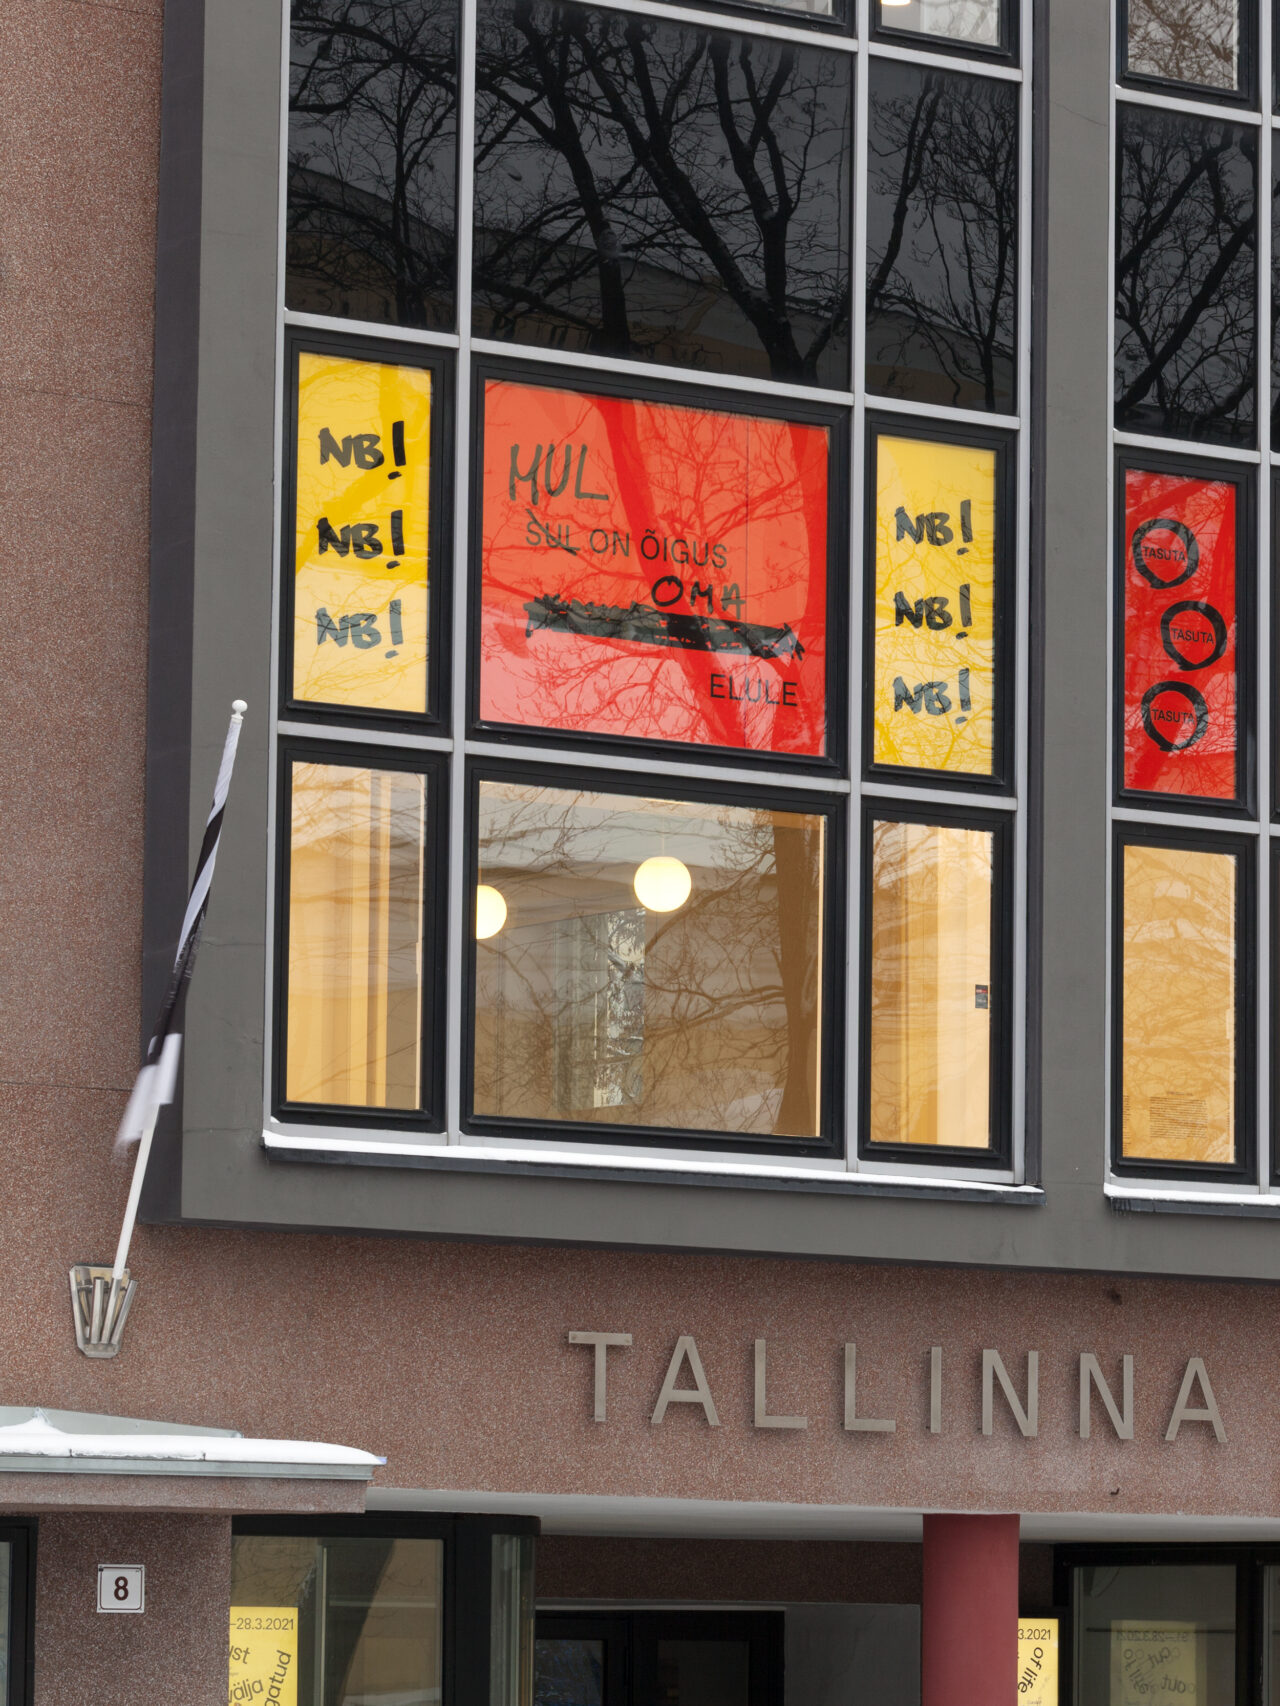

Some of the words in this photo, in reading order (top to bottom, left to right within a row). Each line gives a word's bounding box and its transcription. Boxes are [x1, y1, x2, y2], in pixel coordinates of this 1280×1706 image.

[318, 420, 407, 480] NB!
[508, 442, 609, 505] MUL
[317, 509, 405, 569] NB!
[589, 530, 630, 557] ON
[641, 527, 728, 570] ÕIGUS
[895, 500, 973, 554] NB!
[1142, 545, 1186, 563] TASUTA
[651, 575, 746, 621] OMA
[893, 584, 972, 639] NB!
[315, 600, 404, 659] NB!
[1170, 626, 1214, 644] TASUTA
[710, 674, 798, 708] ELULE
[893, 668, 971, 724] NB!
[1152, 708, 1195, 725] TASUTA
[568, 1331, 1227, 1442] TALLINNA
[114, 1576, 129, 1600] 8
[1018, 1667, 1037, 1693] life
[1030, 1647, 1043, 1670] of
